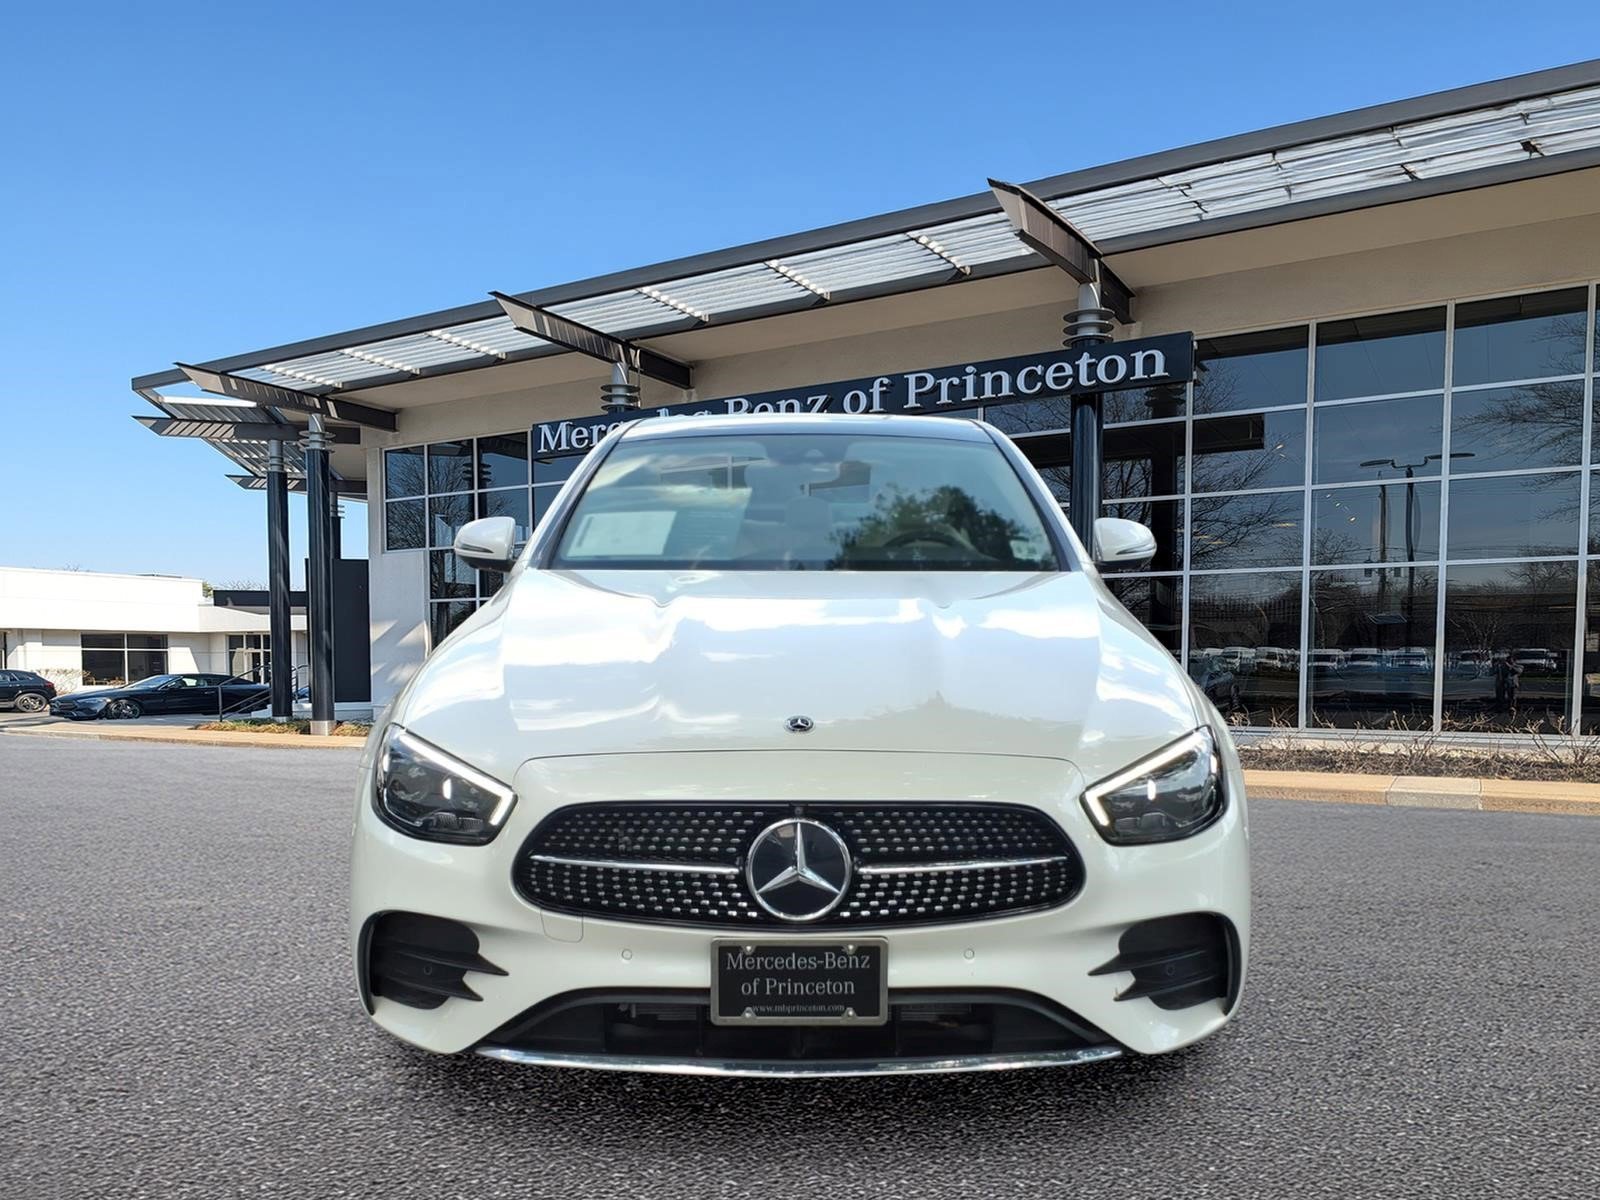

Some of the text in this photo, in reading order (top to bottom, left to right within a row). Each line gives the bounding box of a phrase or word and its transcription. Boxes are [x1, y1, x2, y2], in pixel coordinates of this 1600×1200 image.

[843, 377, 891, 414] of
[903, 348, 1169, 408] Princeton
[726, 951, 871, 970] Mercedes-Benz
[741, 978, 855, 995] of Princeton
[752, 1003, 845, 1014] www.mbprinceton.com
